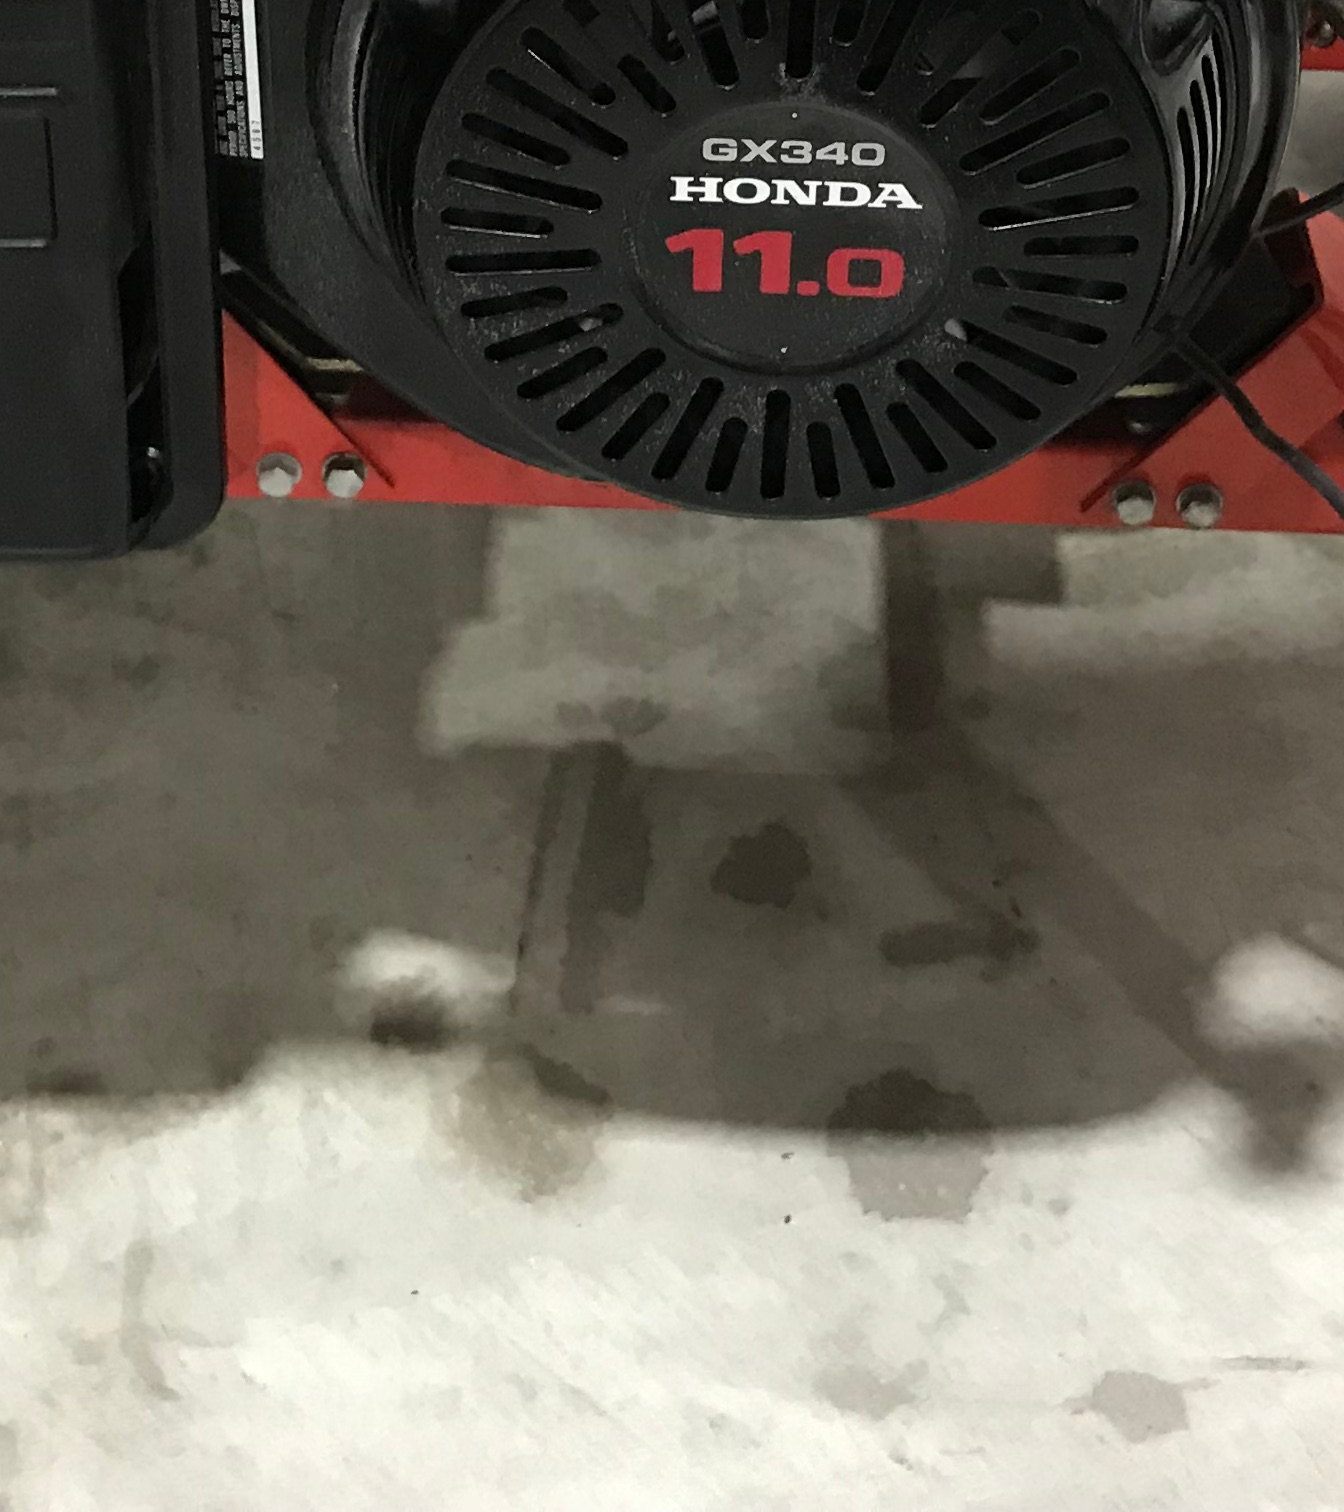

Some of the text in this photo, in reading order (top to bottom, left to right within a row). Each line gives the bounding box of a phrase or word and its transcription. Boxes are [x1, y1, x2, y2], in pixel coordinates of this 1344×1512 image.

[701, 137, 886, 167] GX340
[669, 175, 924, 210] HONDA
[664, 227, 905, 300] 11.0
